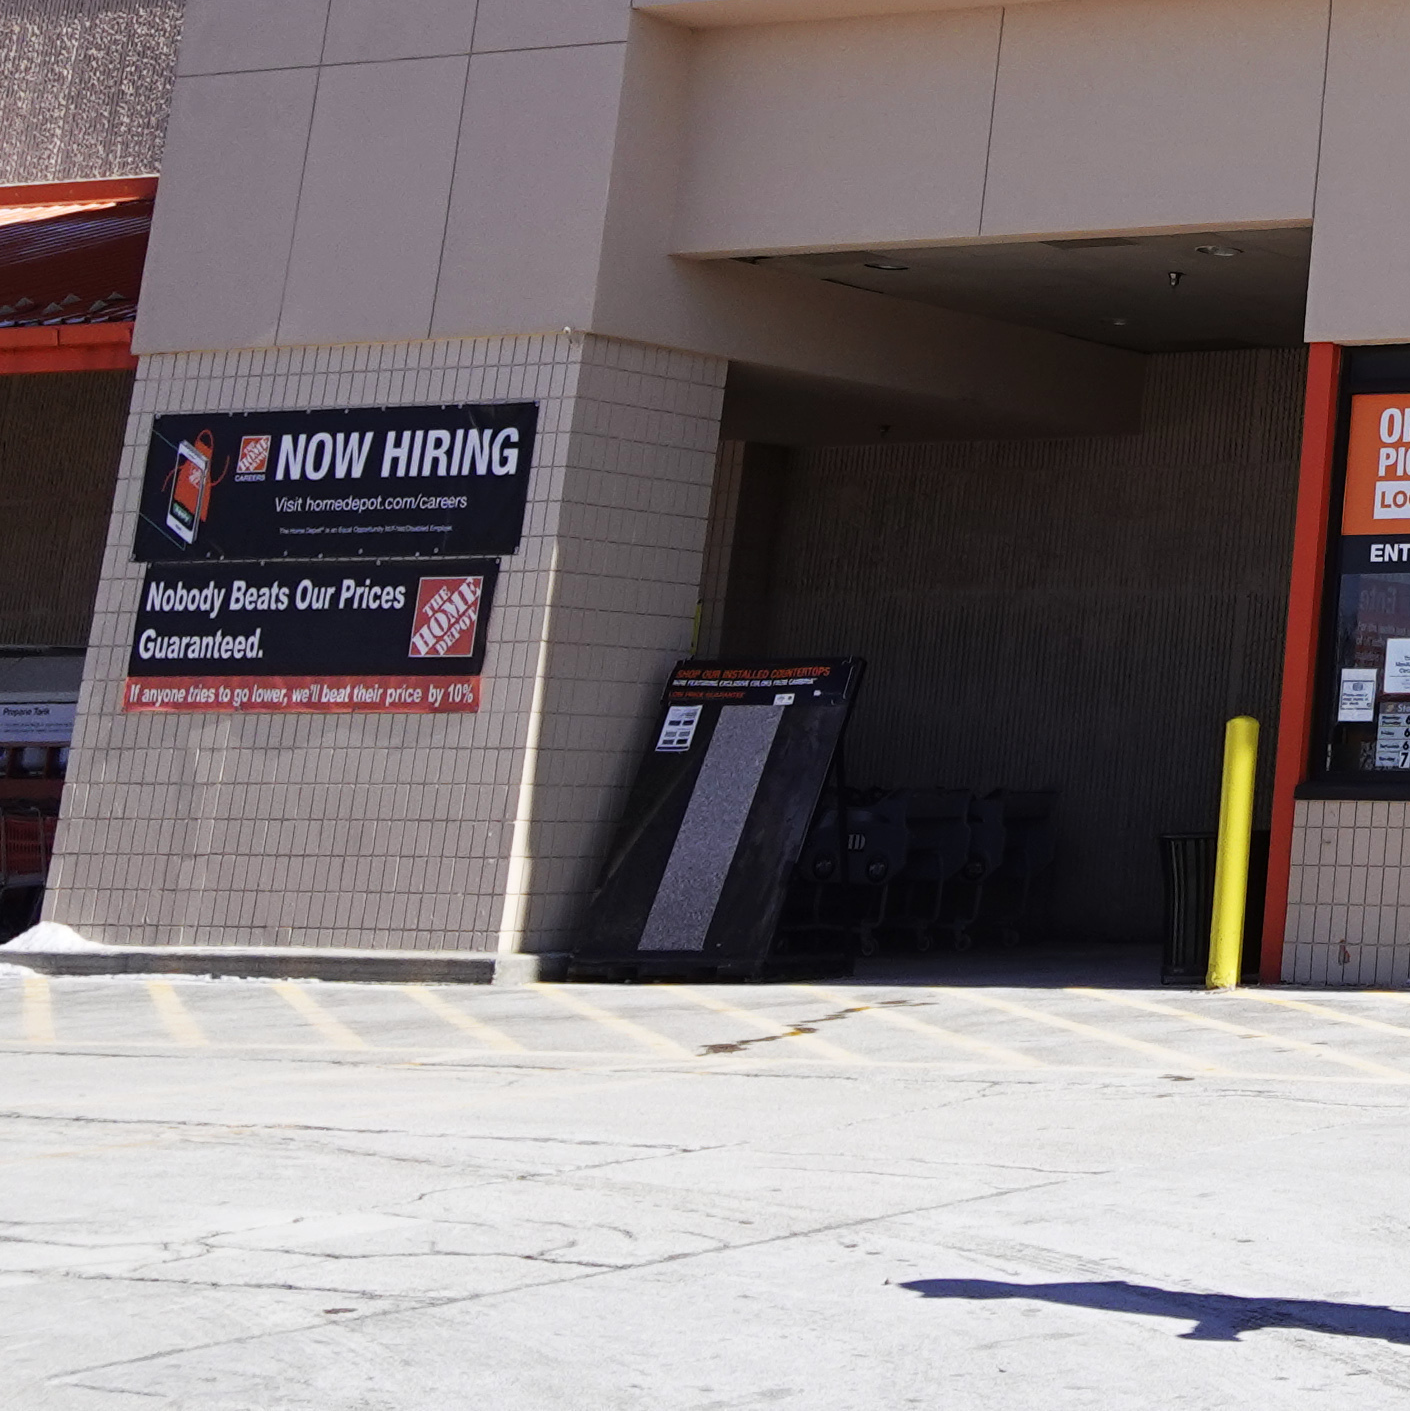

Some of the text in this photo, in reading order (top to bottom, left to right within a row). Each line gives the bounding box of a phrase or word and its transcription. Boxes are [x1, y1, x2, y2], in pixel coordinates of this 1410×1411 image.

[275, 427, 519, 480] NOW HIRING
[275, 494, 467, 513] Visit homedepot.com/careers
[146, 576, 405, 618] Nobody Beats Our Prices
[422, 586, 451, 617] THE
[412, 577, 480, 655] HOME
[139, 628, 263, 661] Guaranteed.
[434, 607, 477, 655] DEPOT
[676, 666, 831, 679] SHOP OUR INSTALLED COUNTERTOPS
[130, 683, 473, 708] If anyone tries to go lower, we'll beat their price by 10%
[1403, 741, 1409, 751] 6
[1404, 727, 1410, 738] 6
[1401, 752, 1408, 767] 7
